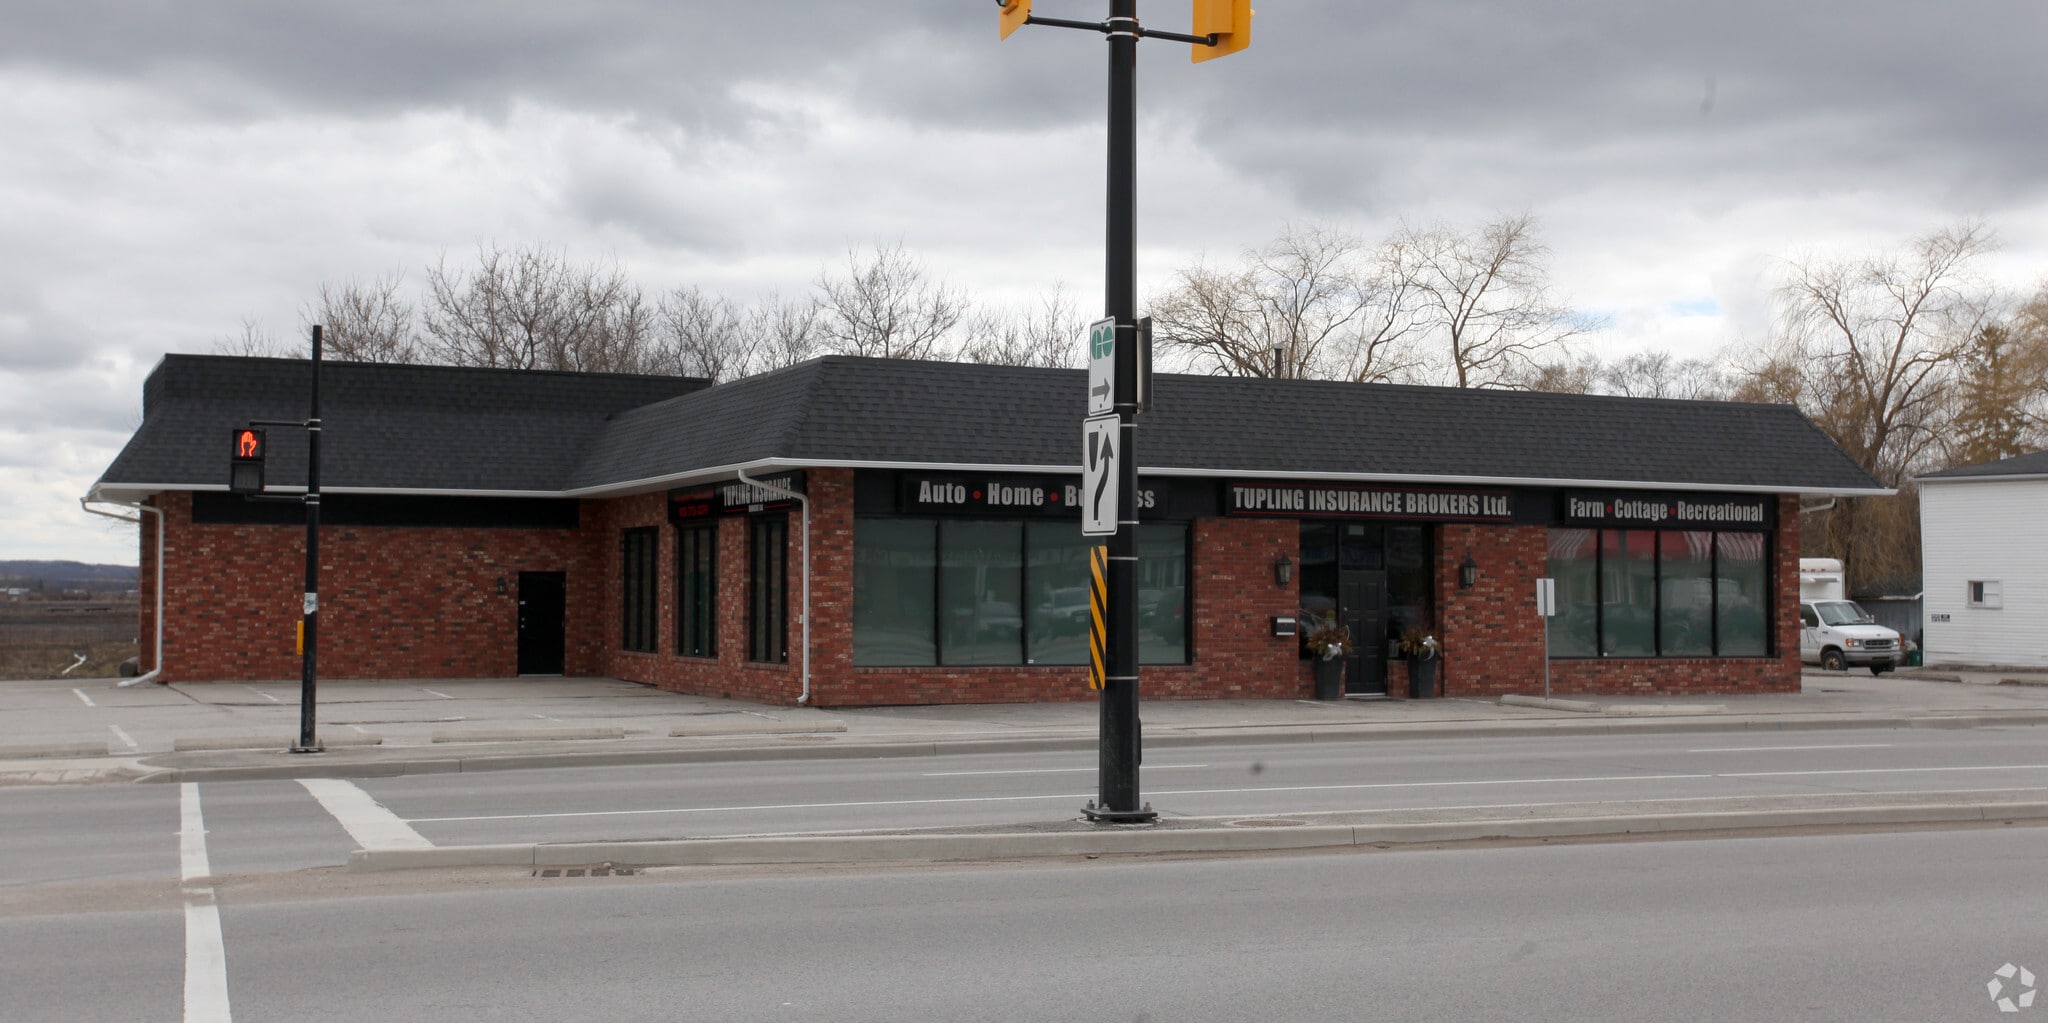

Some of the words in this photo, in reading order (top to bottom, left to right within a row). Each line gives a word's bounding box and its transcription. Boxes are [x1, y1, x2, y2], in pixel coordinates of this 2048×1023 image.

[723, 484, 750, 507] TUPLING
[918, 480, 966, 505] Auto
[987, 483, 1044, 507] Home
[1233, 487, 1304, 510] TUPLING
[1309, 490, 1401, 513] INSURANCE
[1406, 493, 1479, 515] BROKERS
[1483, 495, 1511, 516] Ltd.
[1570, 498, 1604, 518] Farm
[1614, 499, 1668, 521] Cottage
[1677, 501, 1764, 522] Recreational
